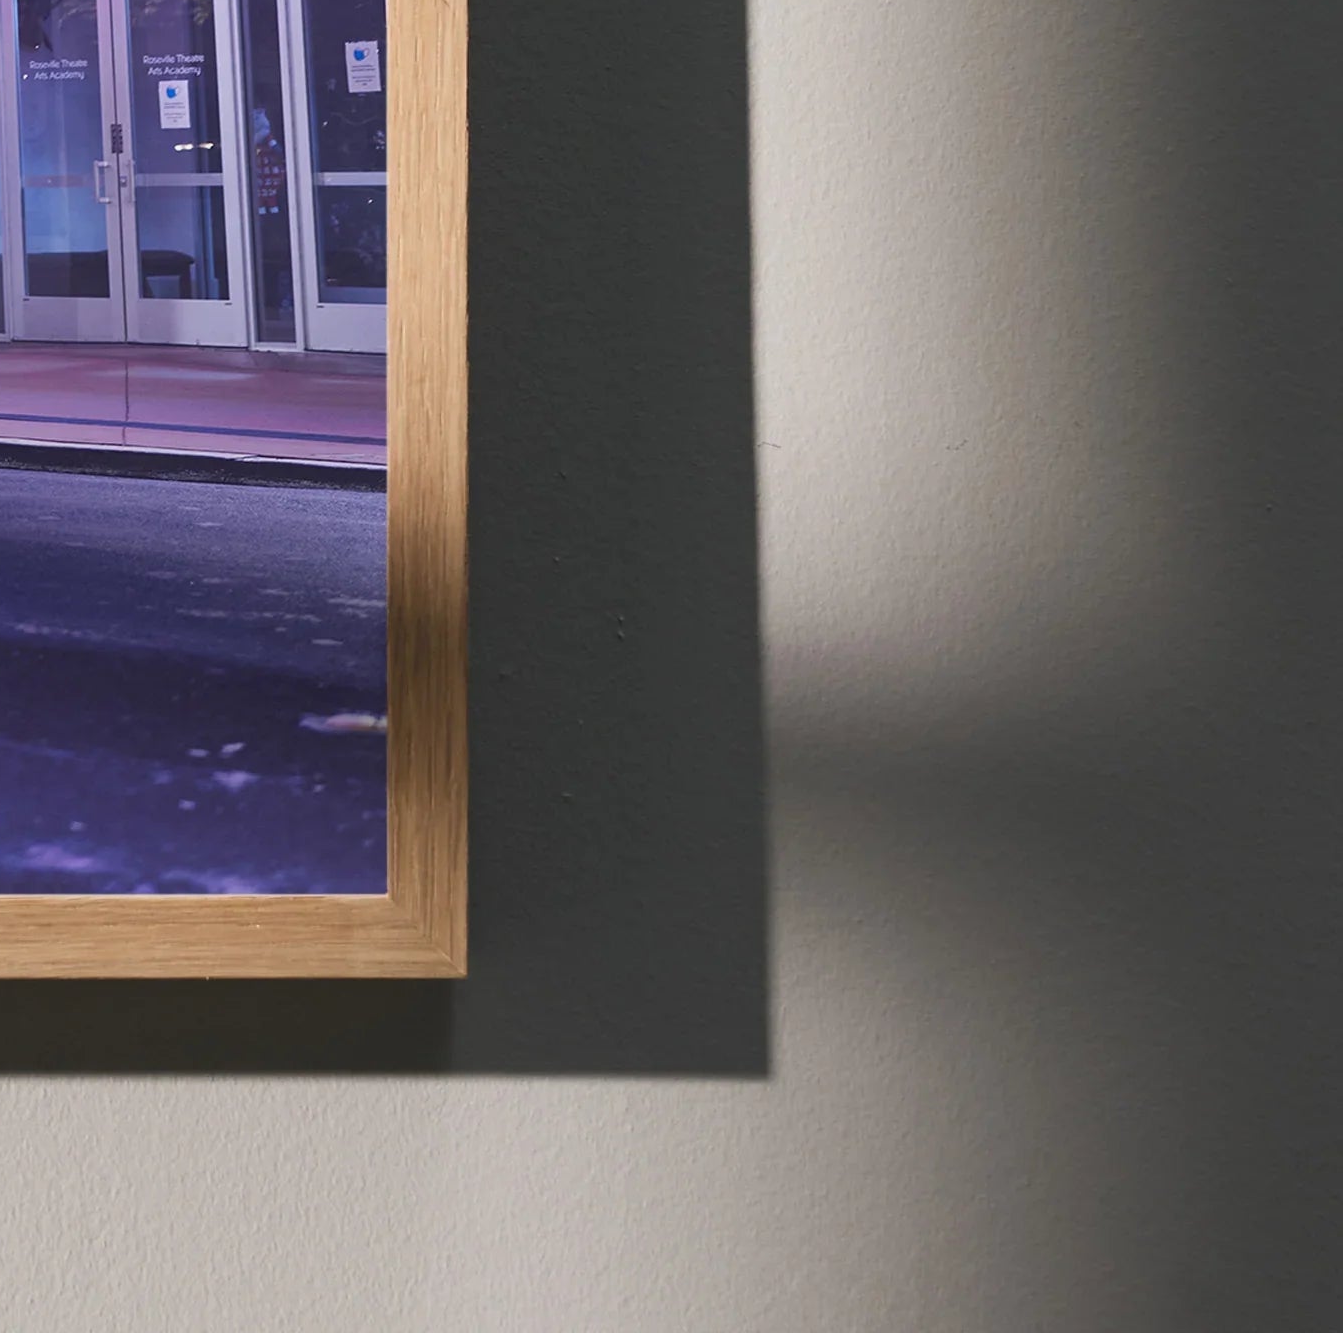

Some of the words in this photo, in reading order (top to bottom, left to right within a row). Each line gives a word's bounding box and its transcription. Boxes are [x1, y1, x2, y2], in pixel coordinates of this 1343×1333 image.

[29, 60, 60, 69] Roseville
[61, 59, 88, 68] Theatre
[142, 55, 175, 64] Roseville
[176, 54, 205, 63] Theatre
[34, 71, 48, 80] Arts
[49, 71, 85, 81] Academy
[147, 66, 163, 76] Arts
[164, 66, 201, 76] Academy
